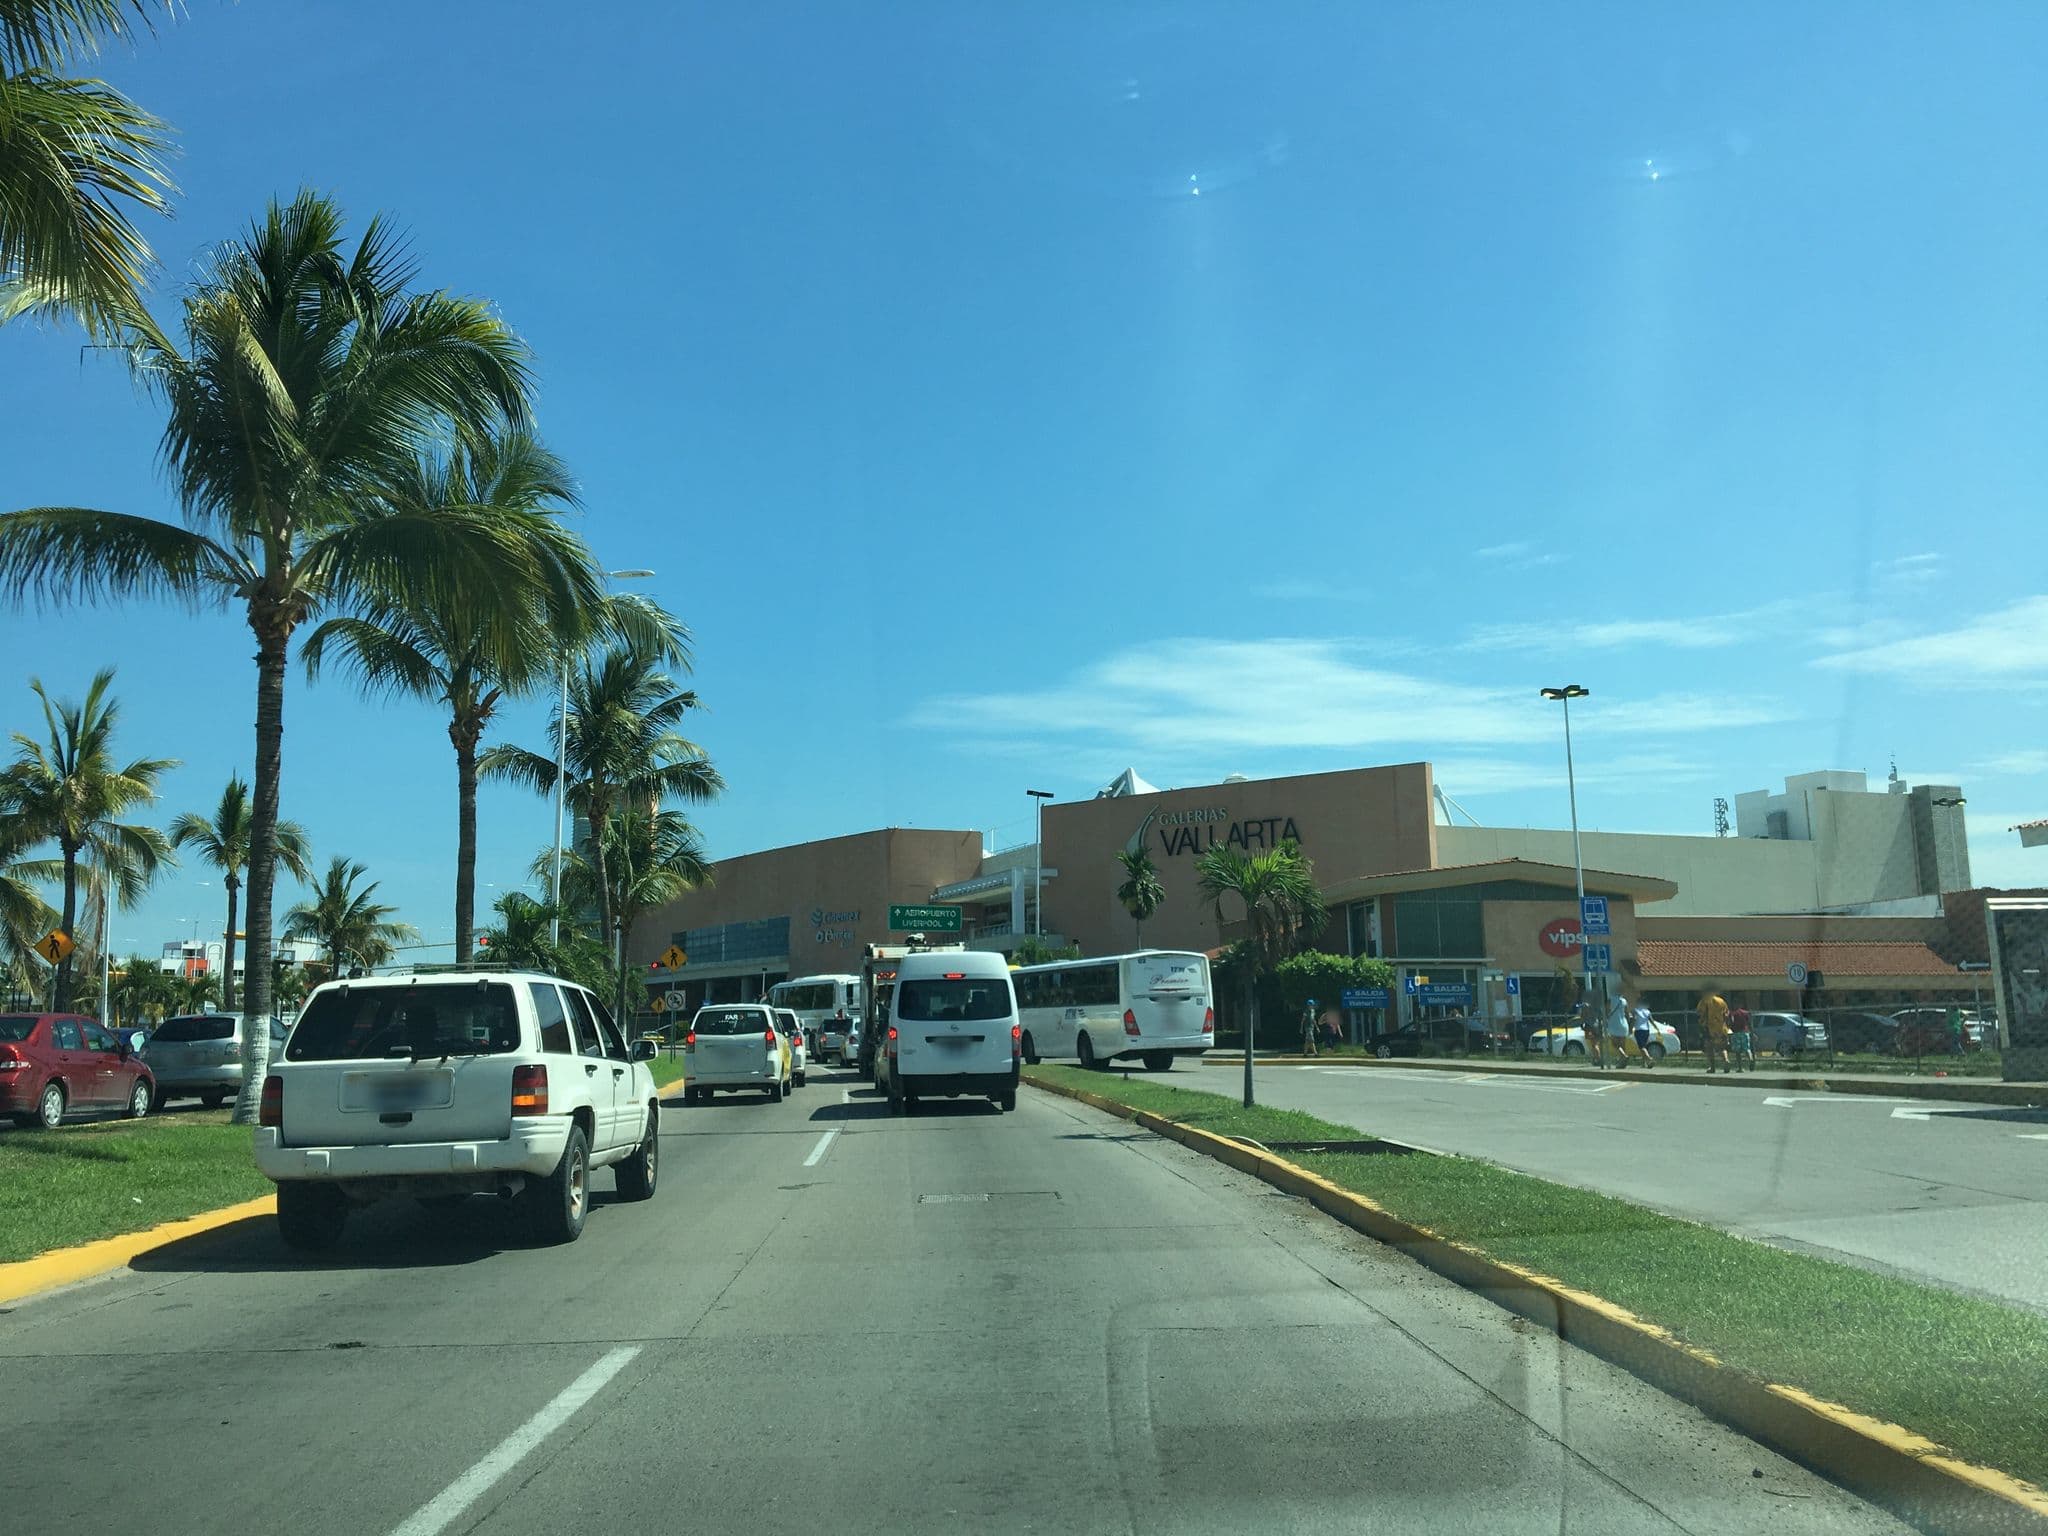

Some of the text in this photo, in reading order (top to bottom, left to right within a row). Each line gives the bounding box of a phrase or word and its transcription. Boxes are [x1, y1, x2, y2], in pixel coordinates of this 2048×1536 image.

[1160, 817, 1303, 857] VALLARTA
[904, 909, 957, 918] AEROPUERTO
[902, 919, 943, 928] LIVERPOOL
[1548, 928, 1583, 949] vips
[1433, 984, 1468, 992] SALIDA
